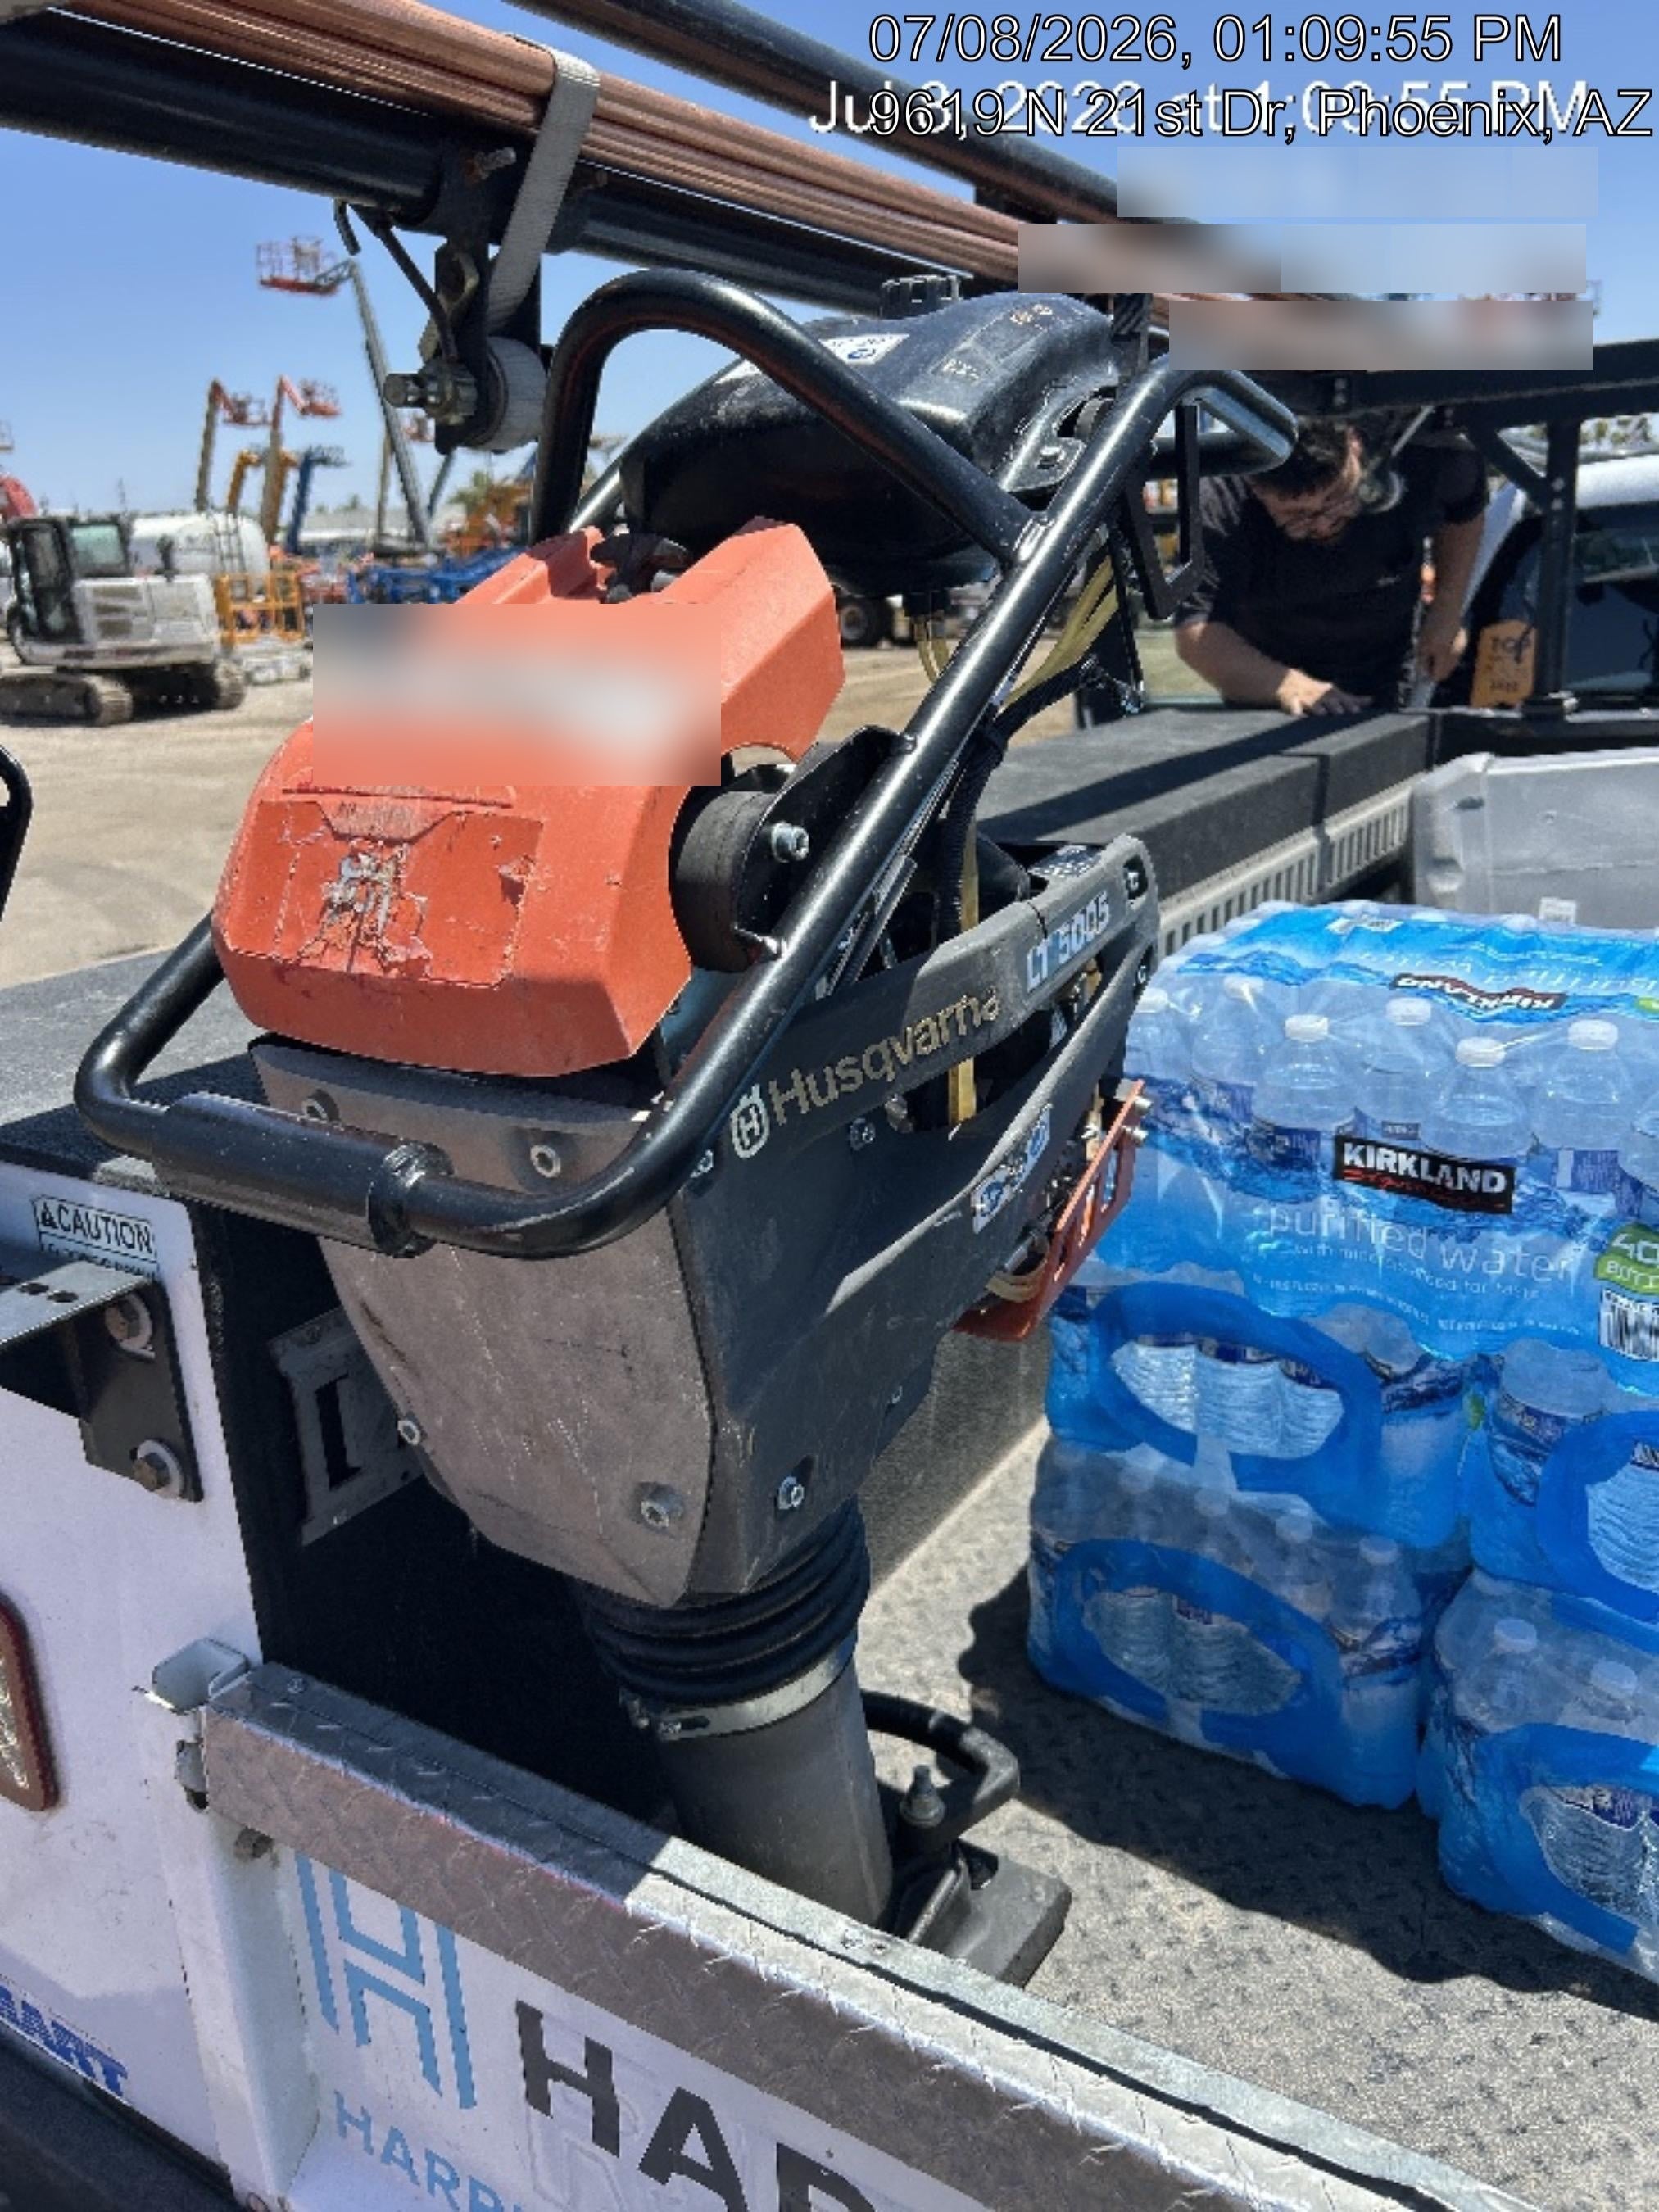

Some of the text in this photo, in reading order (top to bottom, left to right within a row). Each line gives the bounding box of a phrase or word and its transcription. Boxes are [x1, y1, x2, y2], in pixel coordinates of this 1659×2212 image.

[768, 985, 1000, 1126] Husqvarna
[1343, 1142, 1507, 1194] KIRKLAND
[57, 1203, 153, 1254] CAUTION
[1269, 1208, 1428, 1260] purified
[1439, 1240, 1572, 1282] water
